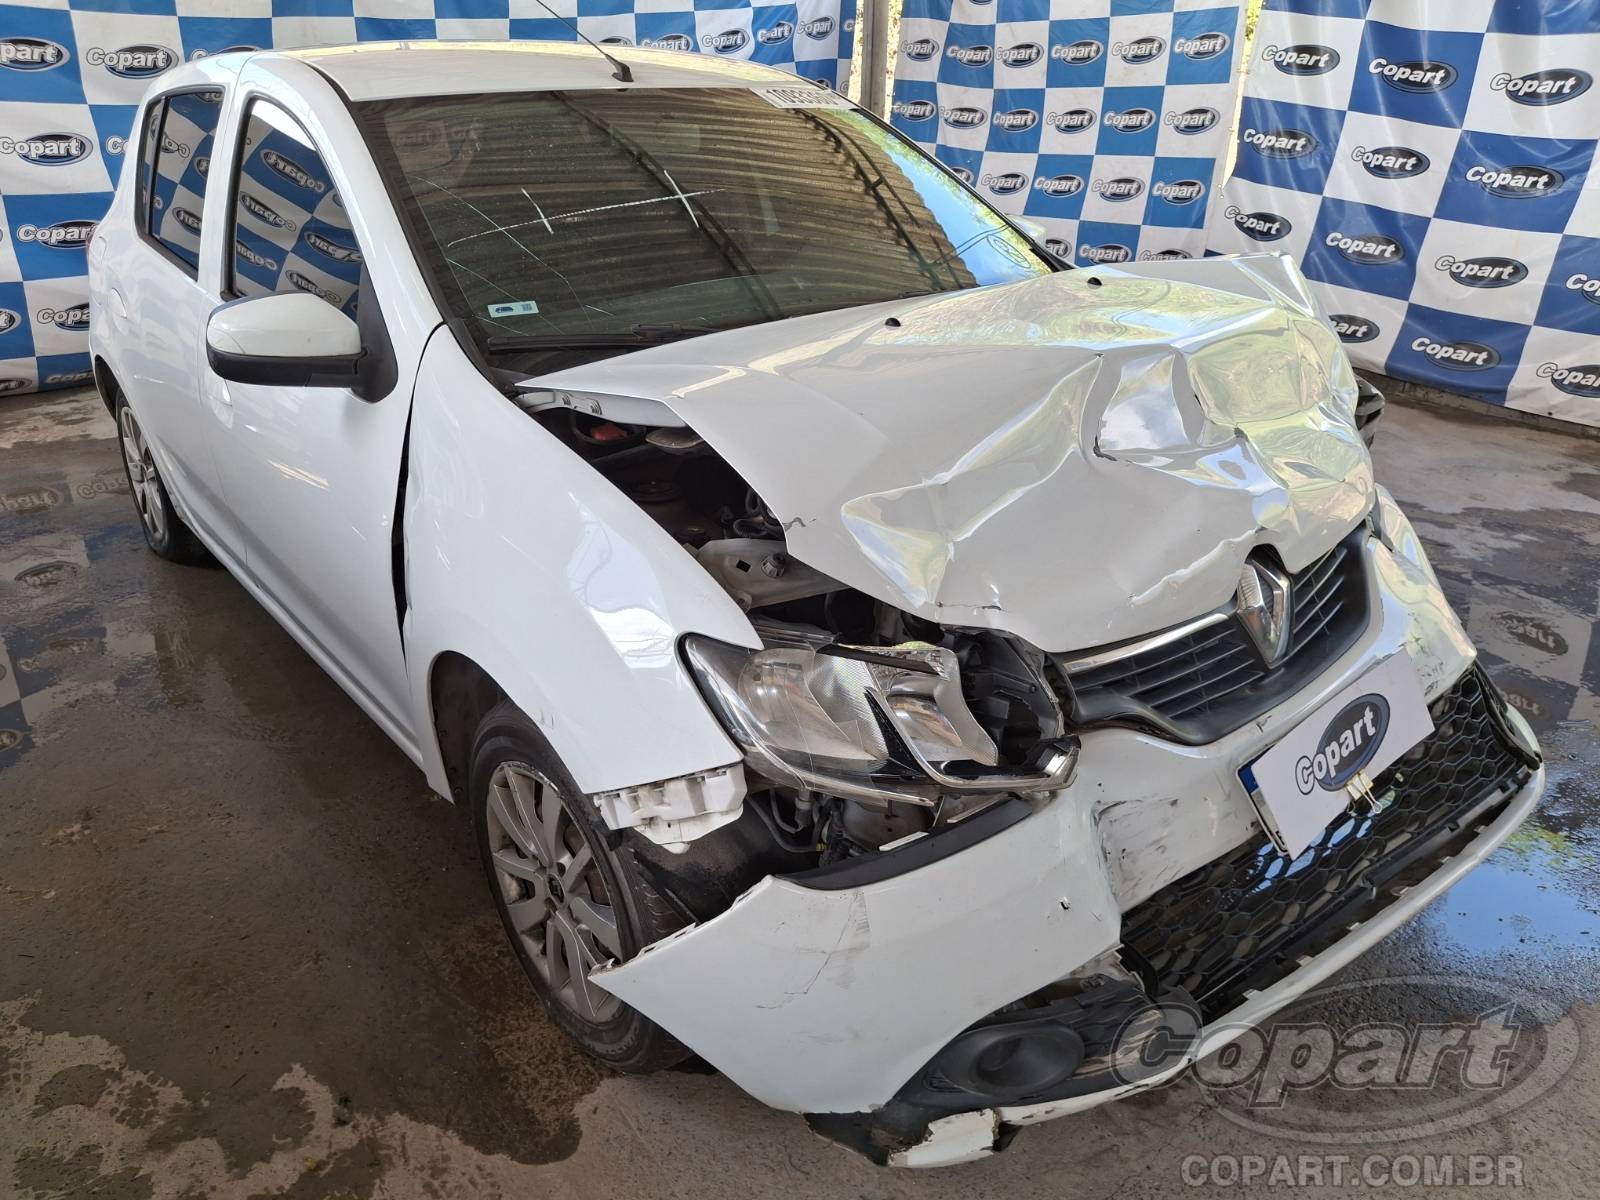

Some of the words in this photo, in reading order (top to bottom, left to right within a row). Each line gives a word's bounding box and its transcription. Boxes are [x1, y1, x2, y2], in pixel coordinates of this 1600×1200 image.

[702, 31, 743, 52] Copart
[1112, 40, 1160, 59] Copart
[1174, 37, 1222, 57] Copart
[0, 43, 57, 65] part
[86, 47, 167, 71] Copart
[947, 46, 990, 63] Copart
[996, 47, 1037, 63] Copart
[1052, 44, 1097, 62] Copart
[1262, 45, 1329, 67] Copart
[1369, 58, 1446, 85] Copart
[1490, 73, 1577, 96] Copart
[894, 102, 931, 117] Copart
[993, 113, 1033, 128] Copart
[1047, 112, 1090, 129] Copart
[1104, 112, 1150, 129] Copart
[1165, 111, 1212, 129] Copart
[0, 137, 81, 159] Copart
[1244, 129, 1307, 151] Copart
[1352, 146, 1417, 170] Copart
[981, 174, 1022, 190] Copart
[1035, 177, 1078, 195] Copart
[1466, 166, 1549, 189] Copart
[1091, 180, 1139, 198] Copart
[1152, 182, 1200, 200] Copart
[1225, 206, 1280, 235] Copart
[1079, 245, 1130, 264] Copart
[1326, 232, 1396, 258] Copart
[1435, 255, 1514, 280] Copart
[1412, 337, 1489, 366] Copart
[1295, 705, 1377, 796] Copart
